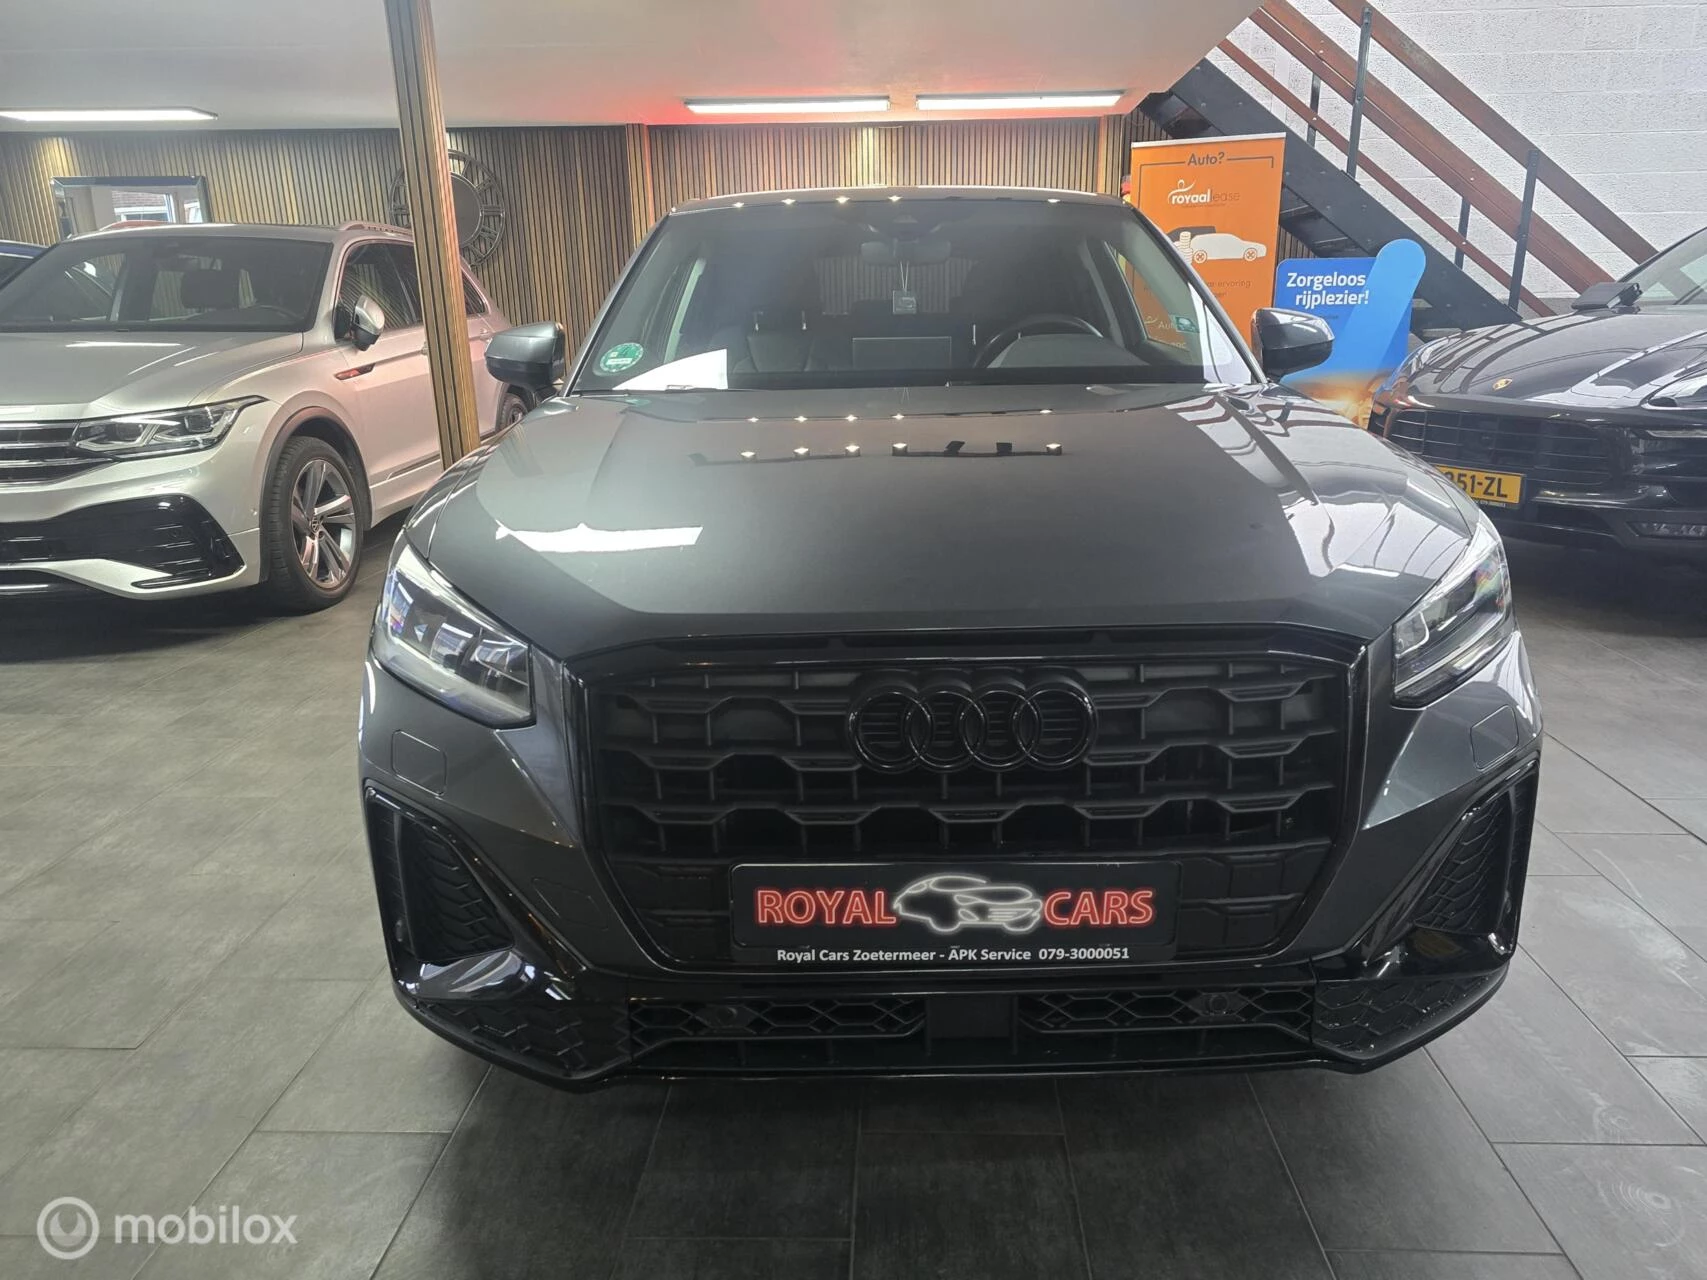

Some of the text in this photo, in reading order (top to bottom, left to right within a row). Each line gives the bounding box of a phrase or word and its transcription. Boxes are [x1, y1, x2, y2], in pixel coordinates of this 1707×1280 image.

[1187, 151, 1225, 166] Auto?
[1286, 272, 1366, 291] Zorgeloos
[1295, 290, 1370, 309] rijplezier!
[757, 890, 1154, 926] ROYAL CARS
[777, 950, 815, 963] Royal
[819, 950, 850, 961] Cars
[853, 950, 936, 961] Zoetermeer
[948, 949, 977, 960] APK
[980, 948, 1031, 960] Service
[1038, 948, 1130, 960] 079-3000051
